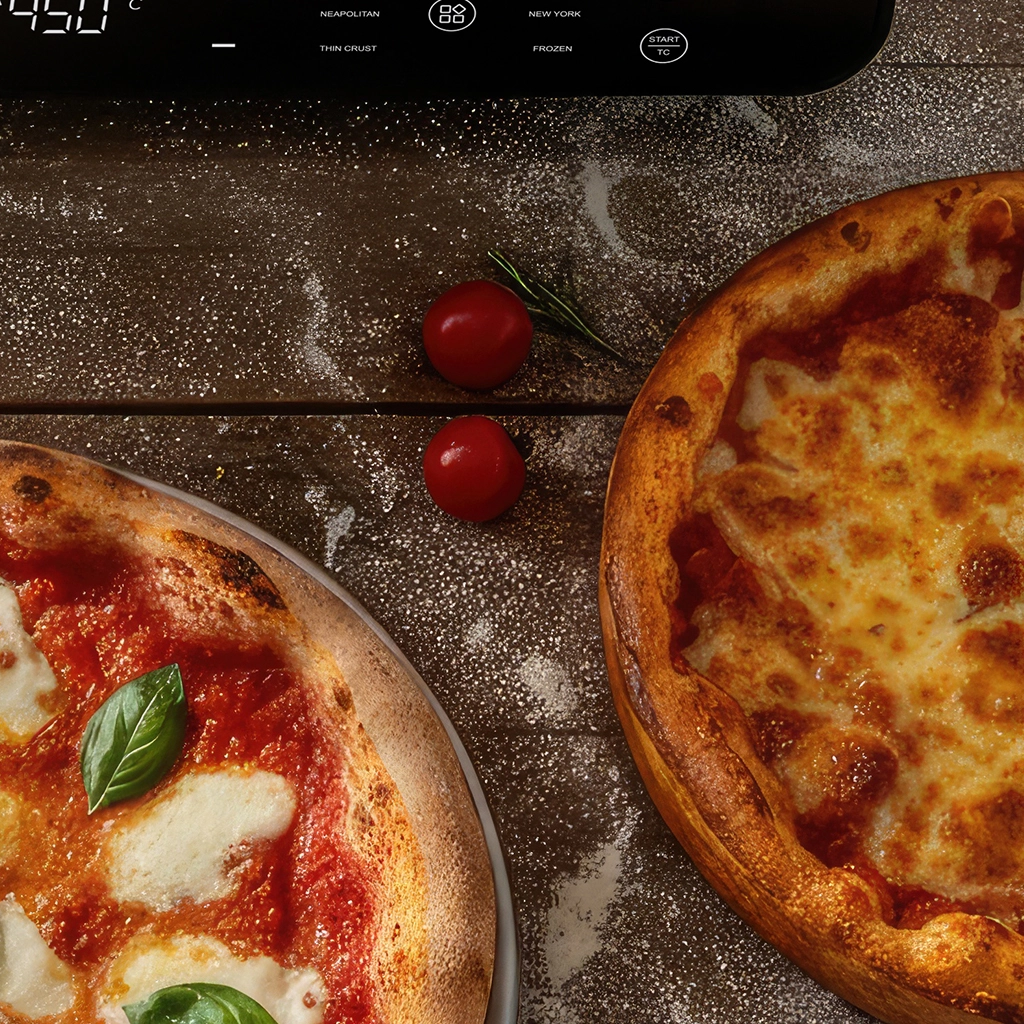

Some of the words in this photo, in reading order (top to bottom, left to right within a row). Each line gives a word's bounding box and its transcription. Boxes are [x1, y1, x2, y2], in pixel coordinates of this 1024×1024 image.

[320, 10, 380, 18] NEAPOLITAN
[528, 10, 552, 18] NEW
[553, 10, 581, 18] YORK
[648, 35, 680, 44] START
[532, 45, 573, 53] FROZEN
[656, 48, 671, 56] TC
